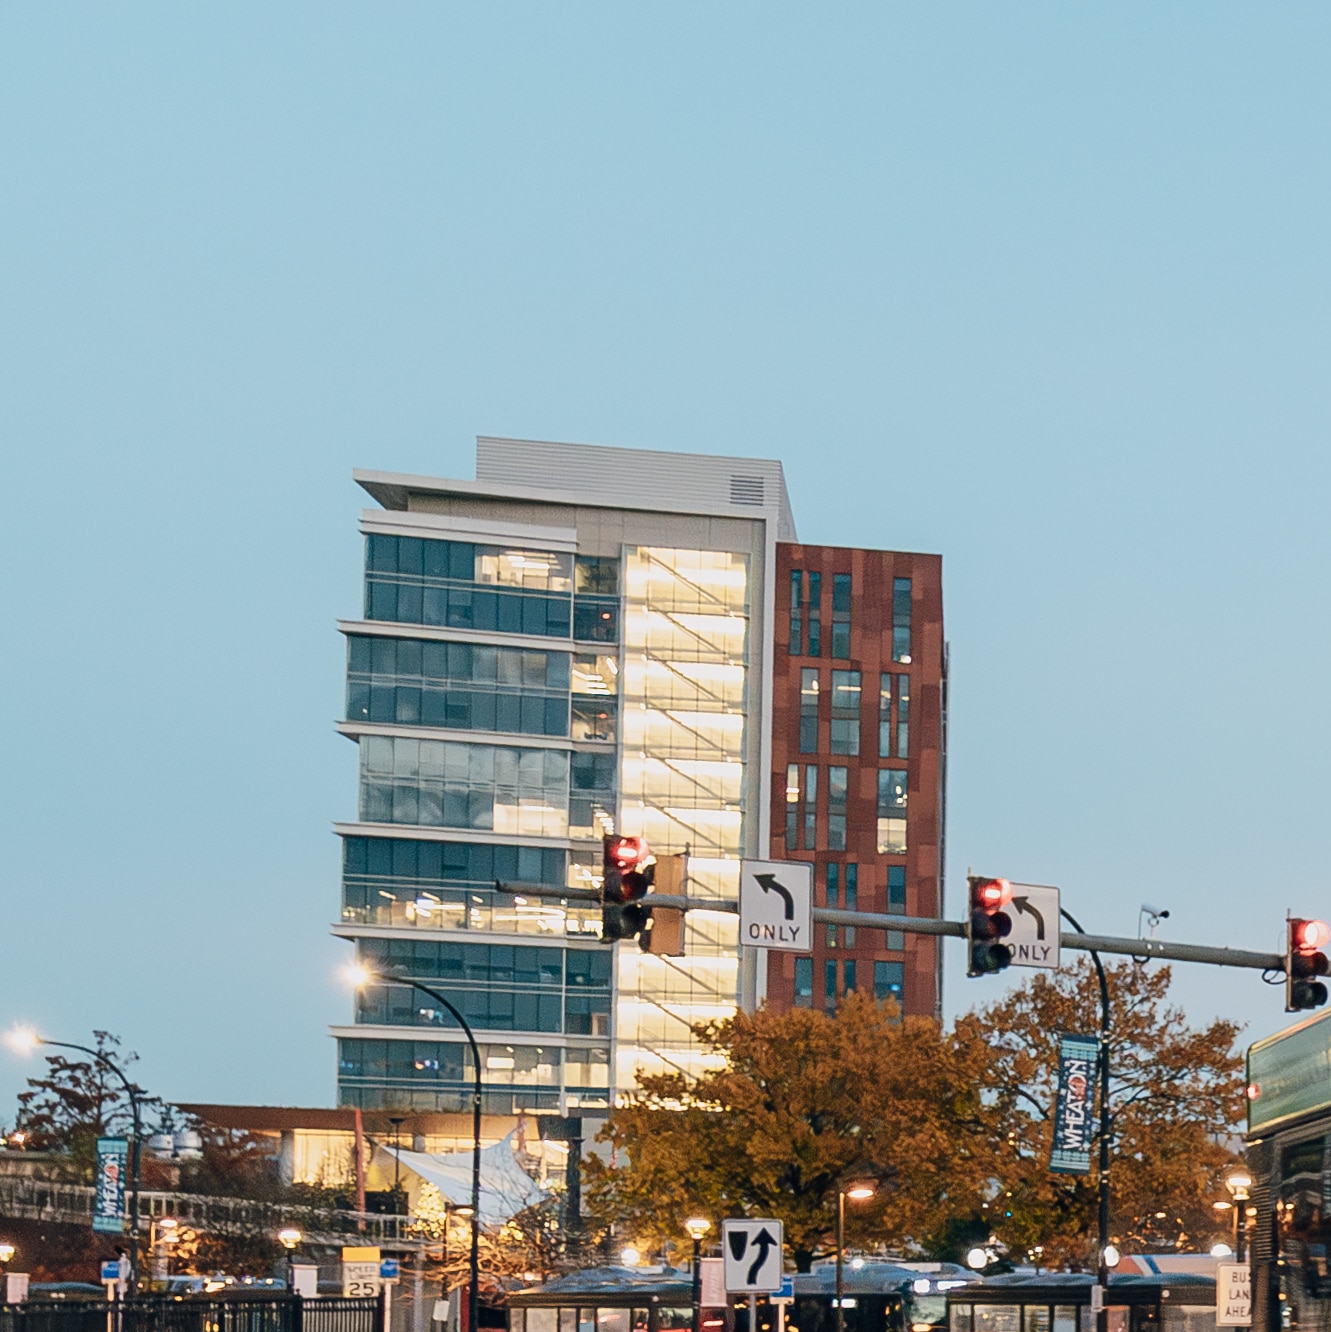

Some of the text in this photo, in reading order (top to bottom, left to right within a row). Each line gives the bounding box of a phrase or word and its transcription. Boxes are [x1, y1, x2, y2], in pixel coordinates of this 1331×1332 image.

[749, 923, 800, 942] ONLY
[1062, 1060, 1087, 1149] WHEATON
[349, 1282, 375, 1296] 25
[1229, 1289, 1250, 1300] LAN
